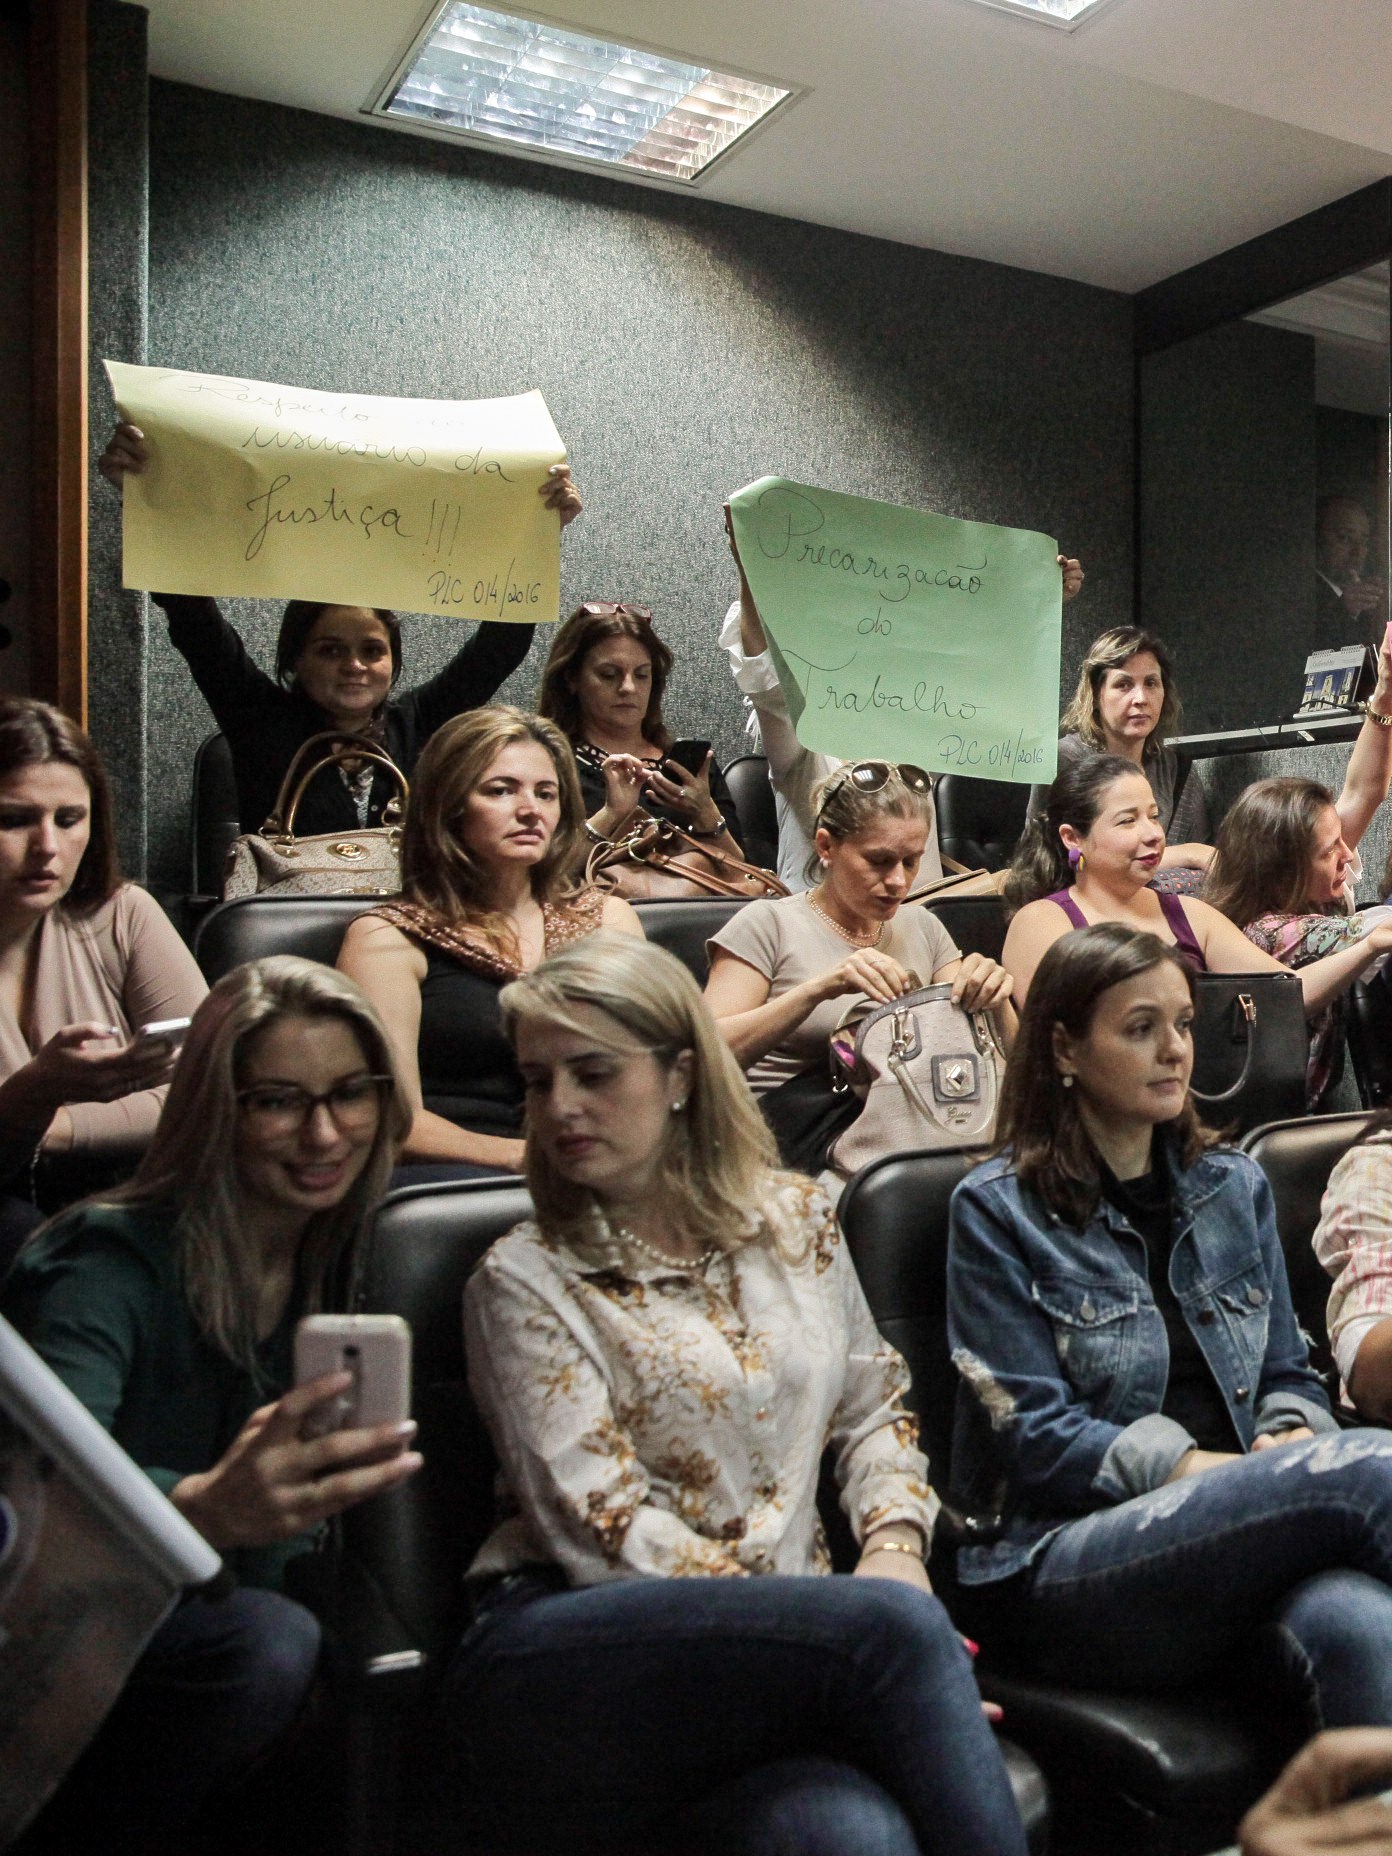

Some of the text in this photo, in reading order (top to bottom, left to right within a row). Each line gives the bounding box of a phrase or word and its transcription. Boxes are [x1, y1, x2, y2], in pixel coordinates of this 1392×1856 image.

[454, 447, 513, 482] da
[427, 557, 542, 617] PLC 014/2016
[857, 607, 892, 636] do
[781, 649, 990, 719] Trabalho
[937, 728, 1044, 777] PLC 014/2016
